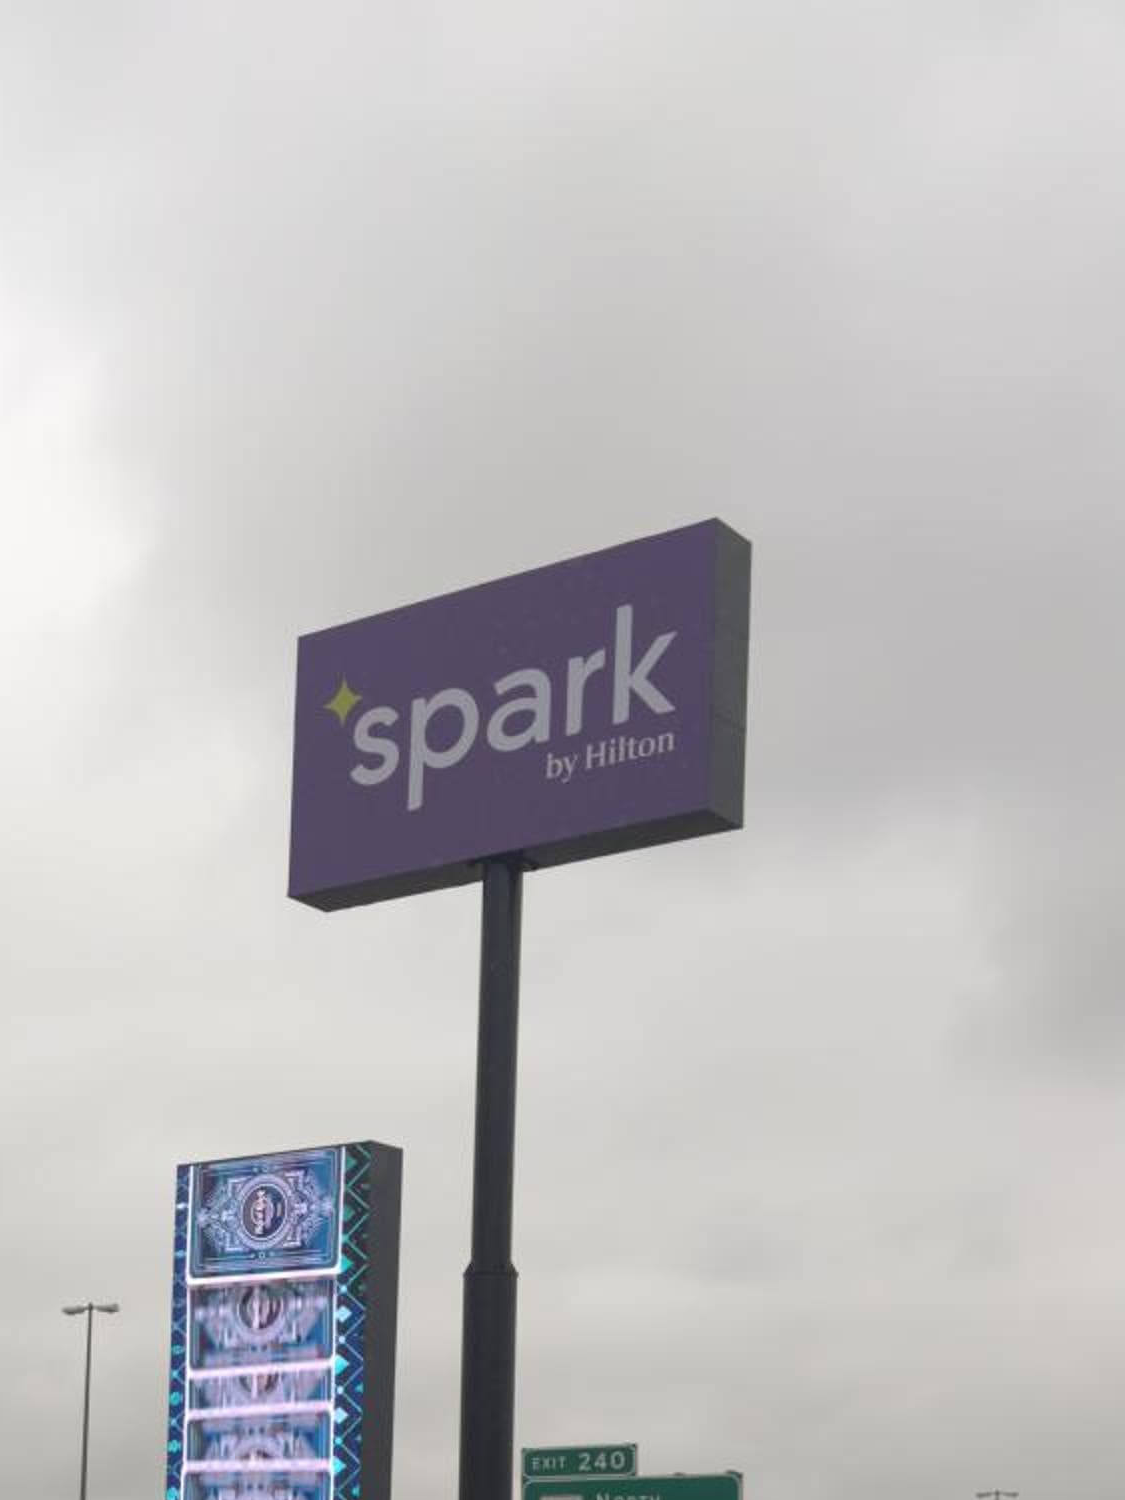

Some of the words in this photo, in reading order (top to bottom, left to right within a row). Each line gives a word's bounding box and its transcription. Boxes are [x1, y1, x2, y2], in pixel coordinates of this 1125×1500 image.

[350, 604, 677, 811] spark
[545, 752, 578, 783] by
[584, 731, 675, 771] Hilton
[532, 1457, 566, 1470] EXIT
[578, 1452, 625, 1471] 240
